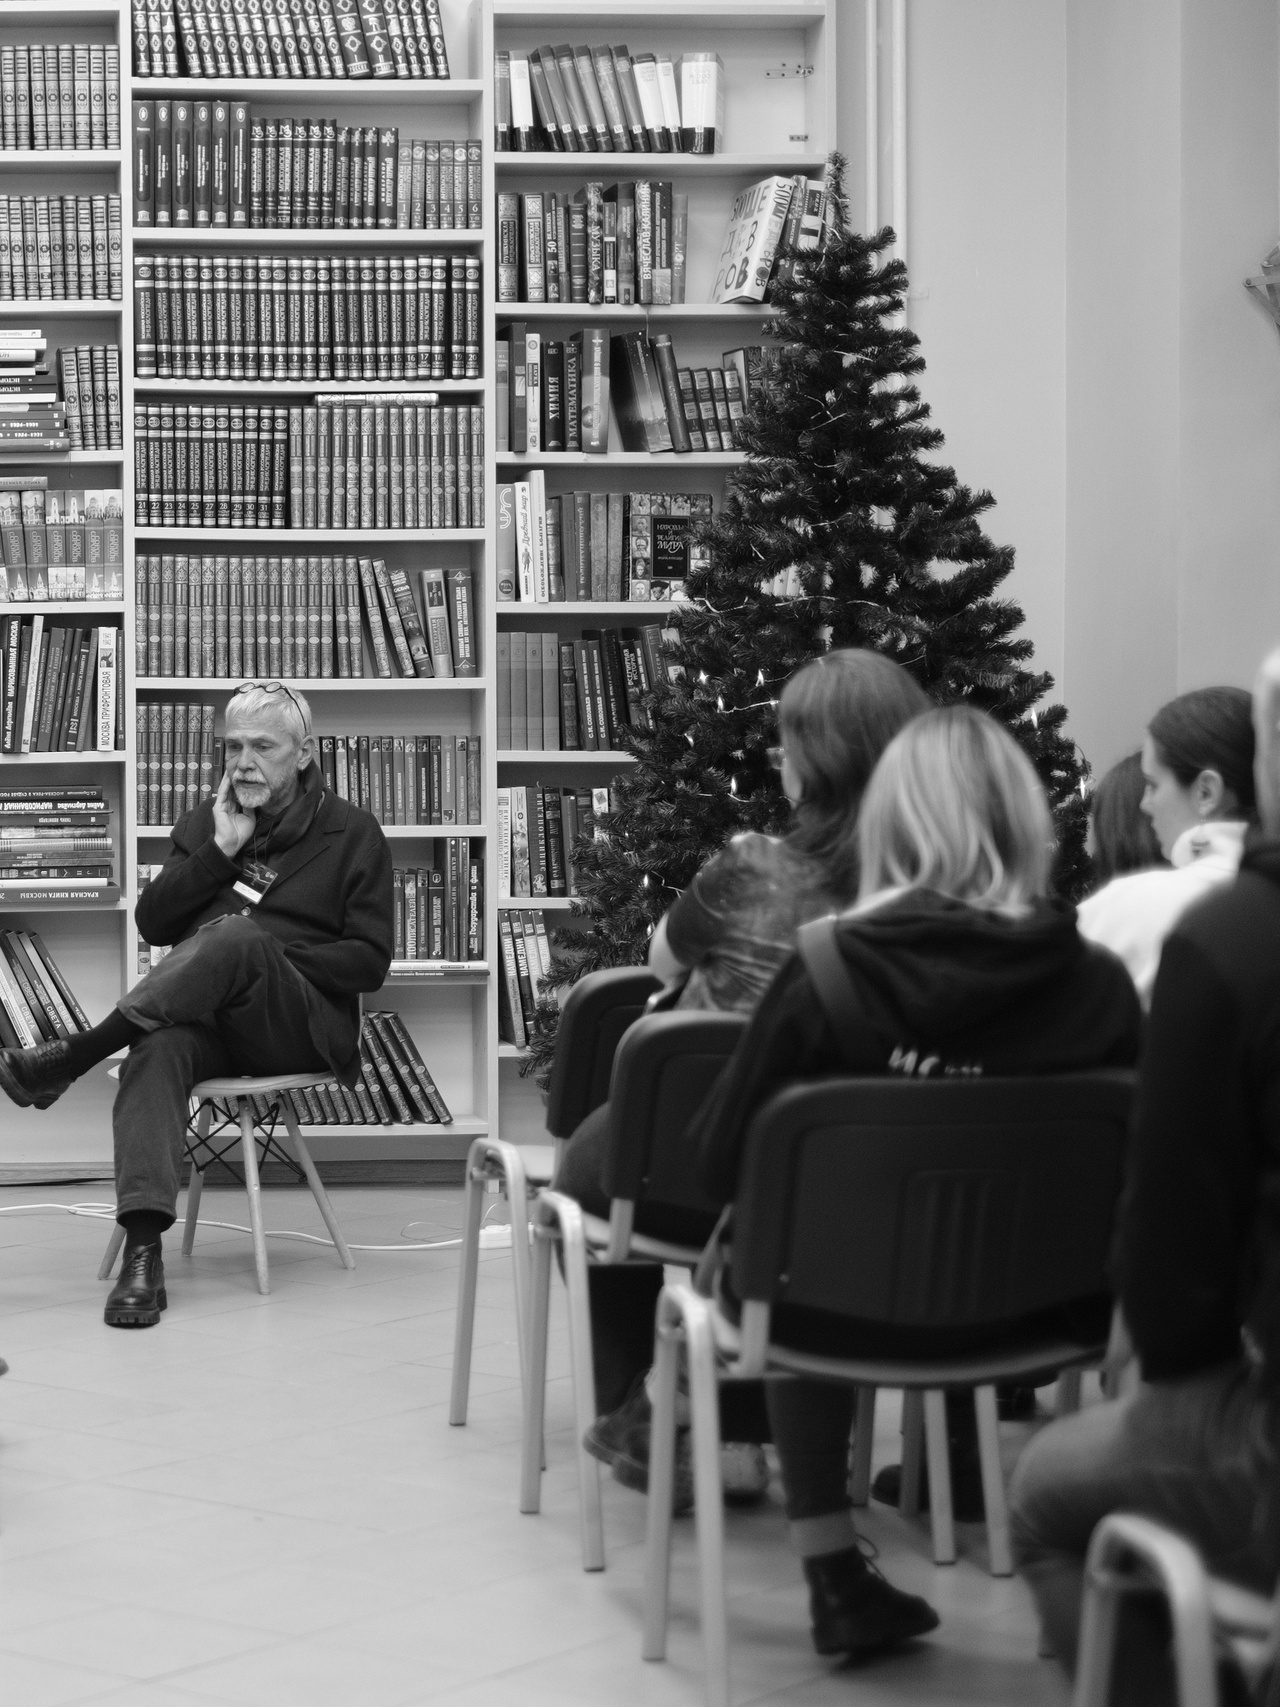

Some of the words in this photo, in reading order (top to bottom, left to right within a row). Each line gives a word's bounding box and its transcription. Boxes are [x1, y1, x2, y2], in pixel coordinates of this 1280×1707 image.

[402, 204, 406, 212] 1
[431, 204, 436, 212] 3
[444, 204, 450, 212] 4
[472, 204, 478, 212] 6
[642, 184, 652, 229] КАЛИНИН
[548, 241, 557, 253] 50
[591, 225, 602, 271] МУЗЫКА
[642, 232, 652, 280] ВЯЧЕСЛАВ
[548, 376, 560, 419] ХИМИЯ
[567, 357, 578, 440] МАТЕМАТИКА
[610, 584, 618, 596] 2
[10, 620, 19, 647] МОСКВА
[7, 648, 17, 697] НАРИСОВАННАЯ
[623, 648, 634, 685] ВСЕМИРНАЯ
[630, 654, 638, 680] ИСТОРИЯ
[102, 671, 111, 720] ПРИФРОНТОВАЯ
[101, 721, 110, 746] МОСКВА
[4, 802, 53, 810] НАРИСОВАННАЯ
[536, 794, 546, 872] ЭНЦИКЛОПЕДИЯ
[470, 866, 478, 883] флаги
[408, 899, 416, 941] ПИСАТЕЛЕЙ
[469, 892, 478, 935] Государства
[407, 940, 416, 955] 100
[505, 937, 517, 977] НАМЕДНИ
[515, 938, 529, 977] НАМЕДНИ
[21, 1006, 36, 1030] СВЕТА
[47, 1006, 62, 1029] СВЕТА
